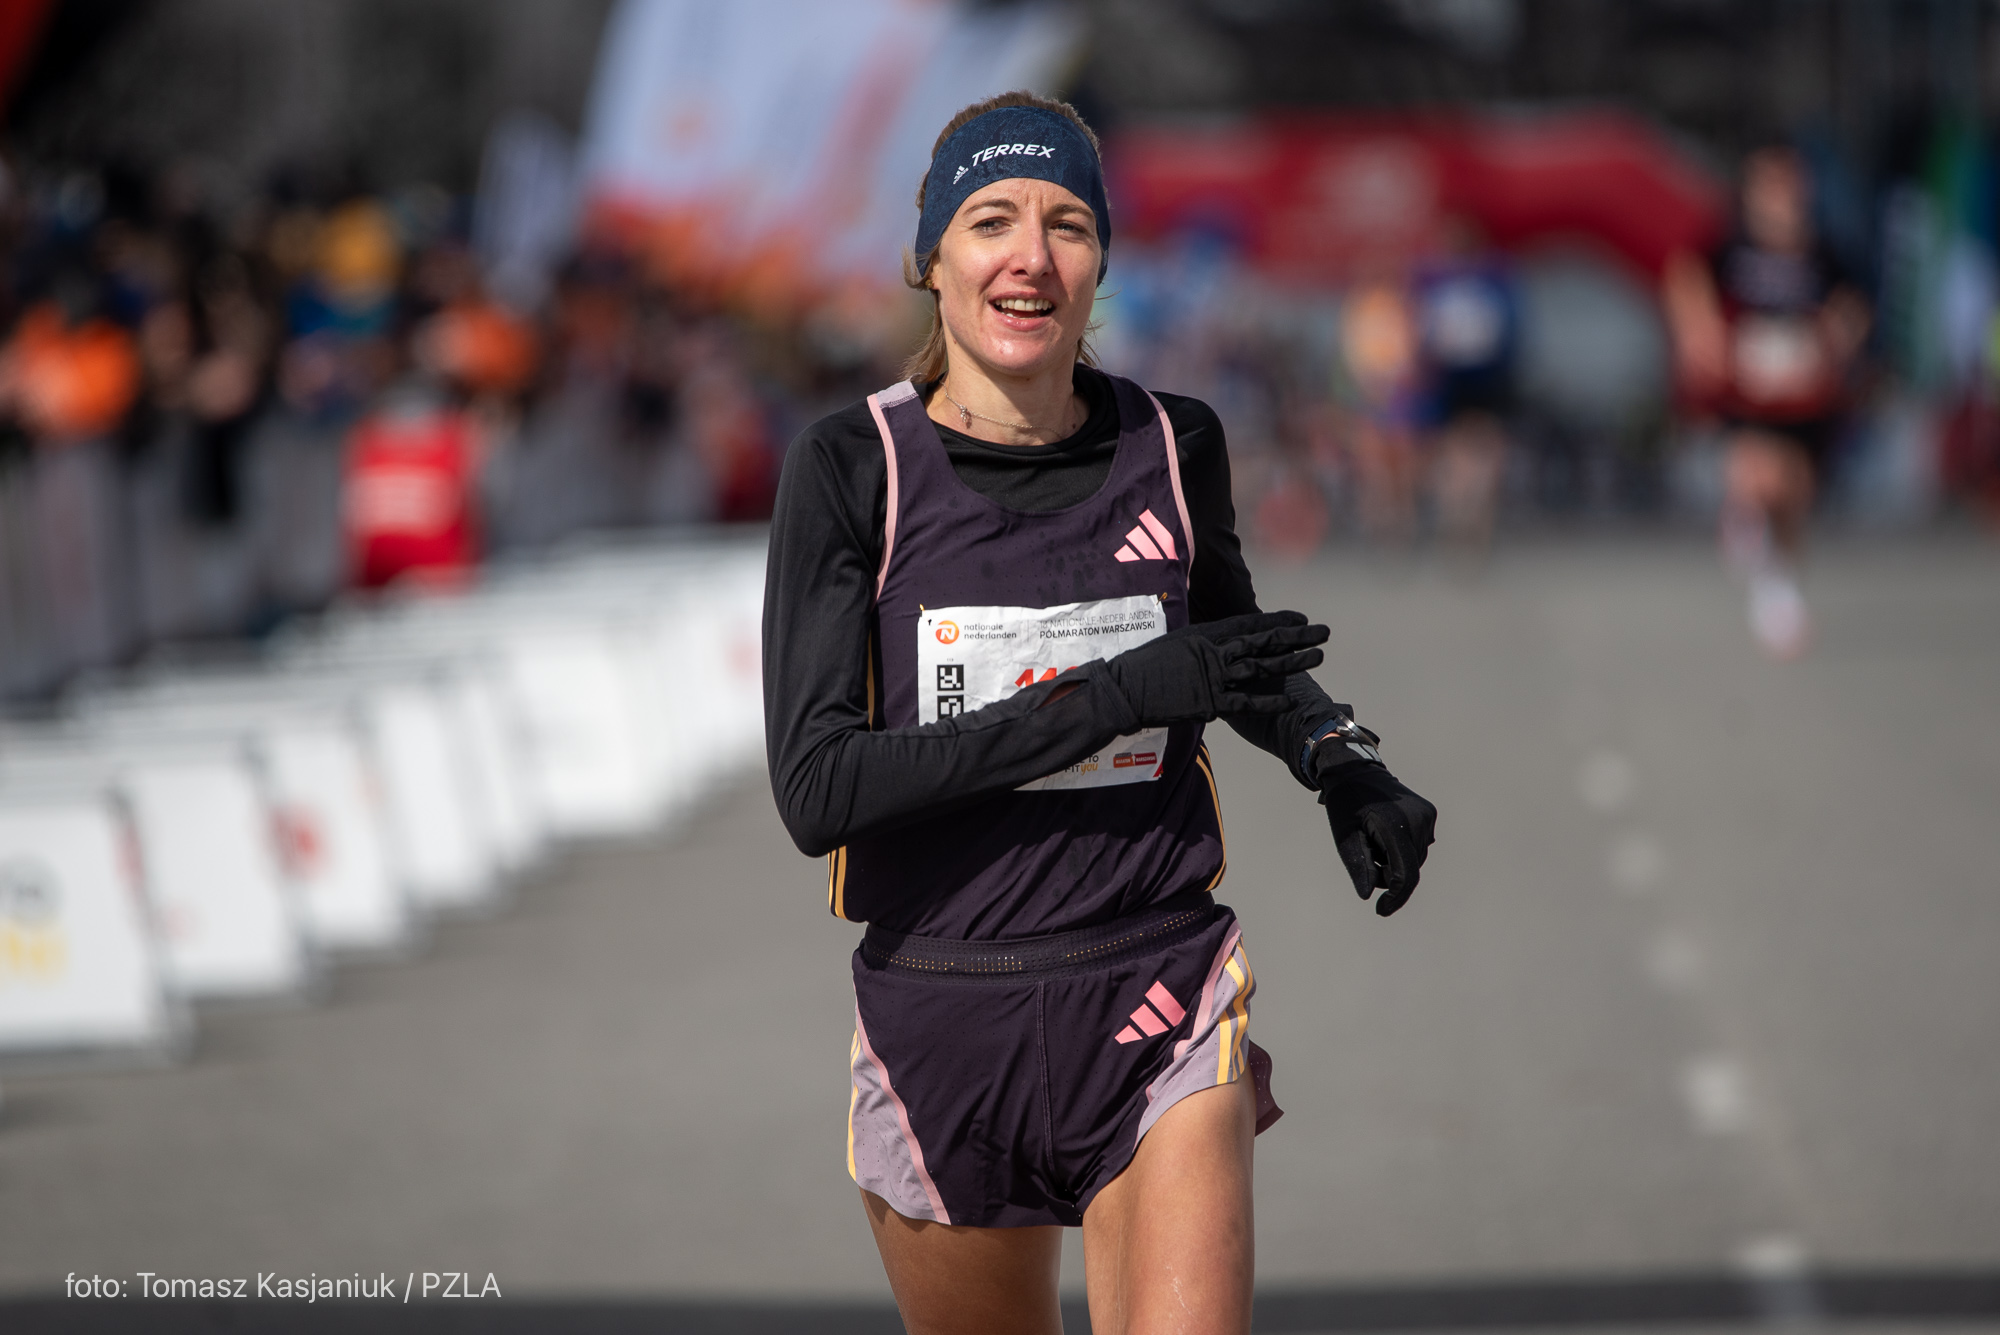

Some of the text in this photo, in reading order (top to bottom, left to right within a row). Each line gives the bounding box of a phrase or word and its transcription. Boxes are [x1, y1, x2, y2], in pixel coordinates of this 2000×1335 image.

[972, 144, 1055, 167] TERREX
[964, 622, 1003, 631] nationale
[1050, 610, 1155, 628] NATIONALE-NEDERLANDEN
[964, 632, 1017, 640] nederlanden
[1039, 620, 1155, 639] PÓŁMARATON WARSZAWSKI
